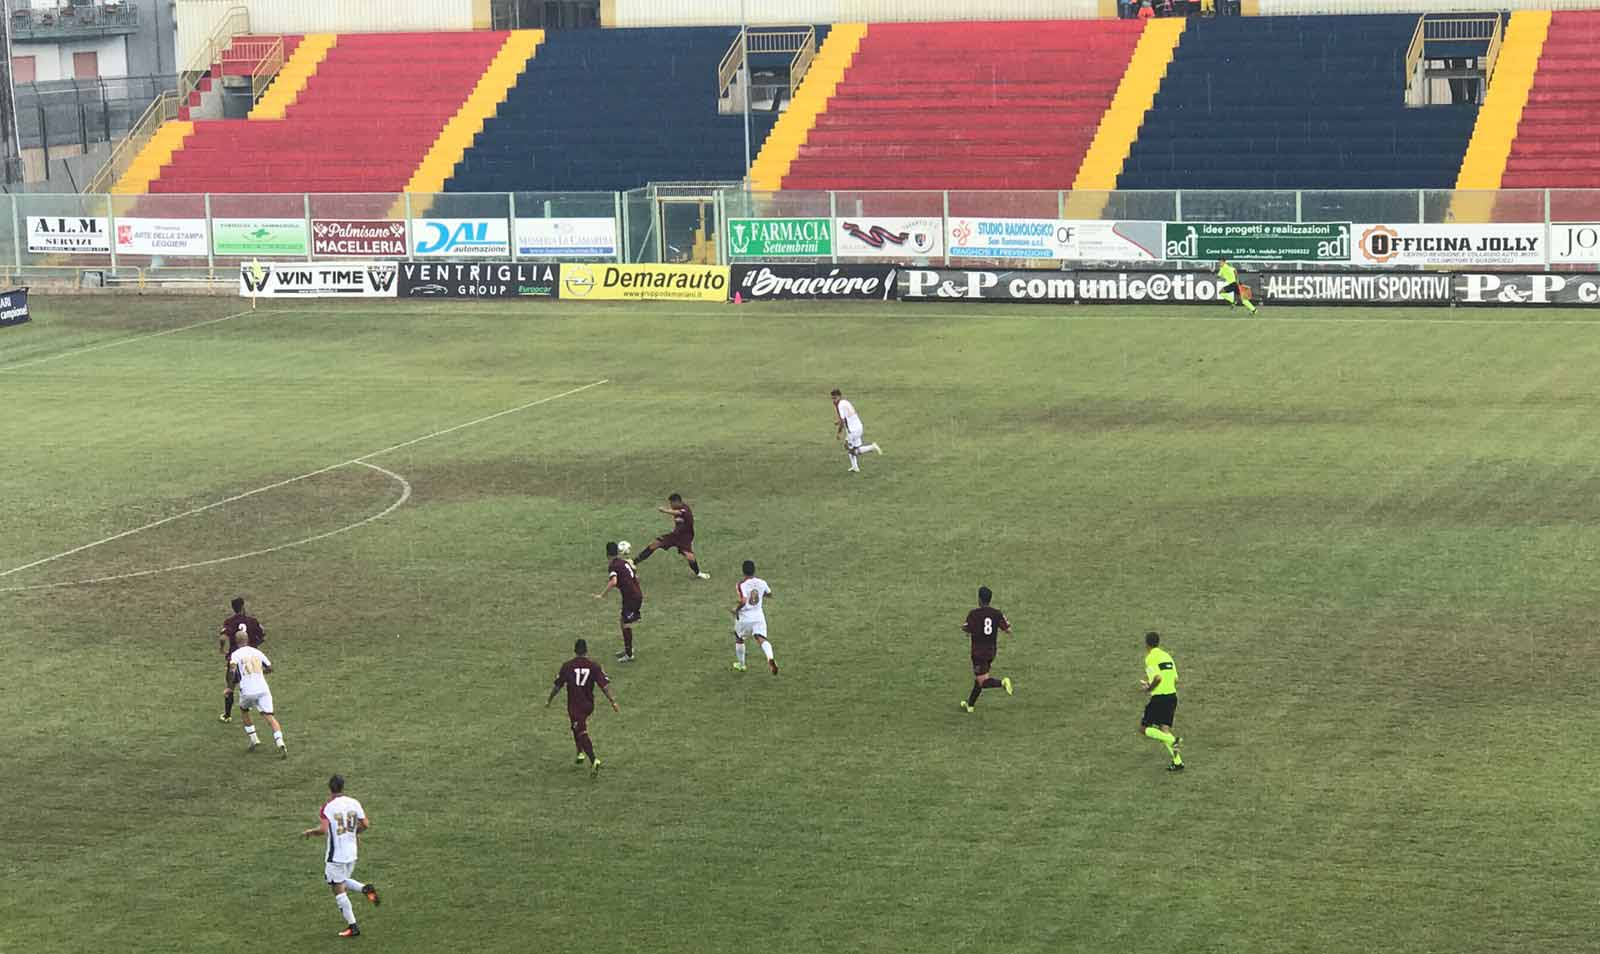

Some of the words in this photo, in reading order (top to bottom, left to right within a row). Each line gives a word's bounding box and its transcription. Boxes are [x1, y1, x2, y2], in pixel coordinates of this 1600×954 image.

[35, 218, 102, 233] A.L.M.
[328, 223, 390, 237] Palmisano
[751, 222, 829, 240] FARMACIA
[978, 222, 1003, 235] STUDIO
[1005, 222, 1054, 236] RADIOLOGICO
[1203, 224, 1223, 234] idee
[1225, 224, 1262, 236] progetti
[1272, 224, 1330, 234] realizzazioni
[315, 240, 405, 253] MACELLERIA
[454, 245, 506, 253] automazione
[763, 240, 818, 253] Settembrini
[1372, 234, 1472, 254] OFFICINA
[1477, 237, 1538, 251] JOLLY
[276, 271, 312, 284] WIN
[319, 271, 363, 284] TIME
[404, 265, 553, 280] VENTRIGLIA
[603, 267, 724, 289] Demarauto
[458, 285, 507, 295] GROUP
[904, 270, 998, 298] P&P
[1267, 276, 1374, 299] ALLESTIMENTI
[1378, 276, 1449, 299] SPORTIVI
[1462, 274, 1566, 303] P&P
[984, 617, 992, 635] 8
[574, 668, 590, 686] 17
